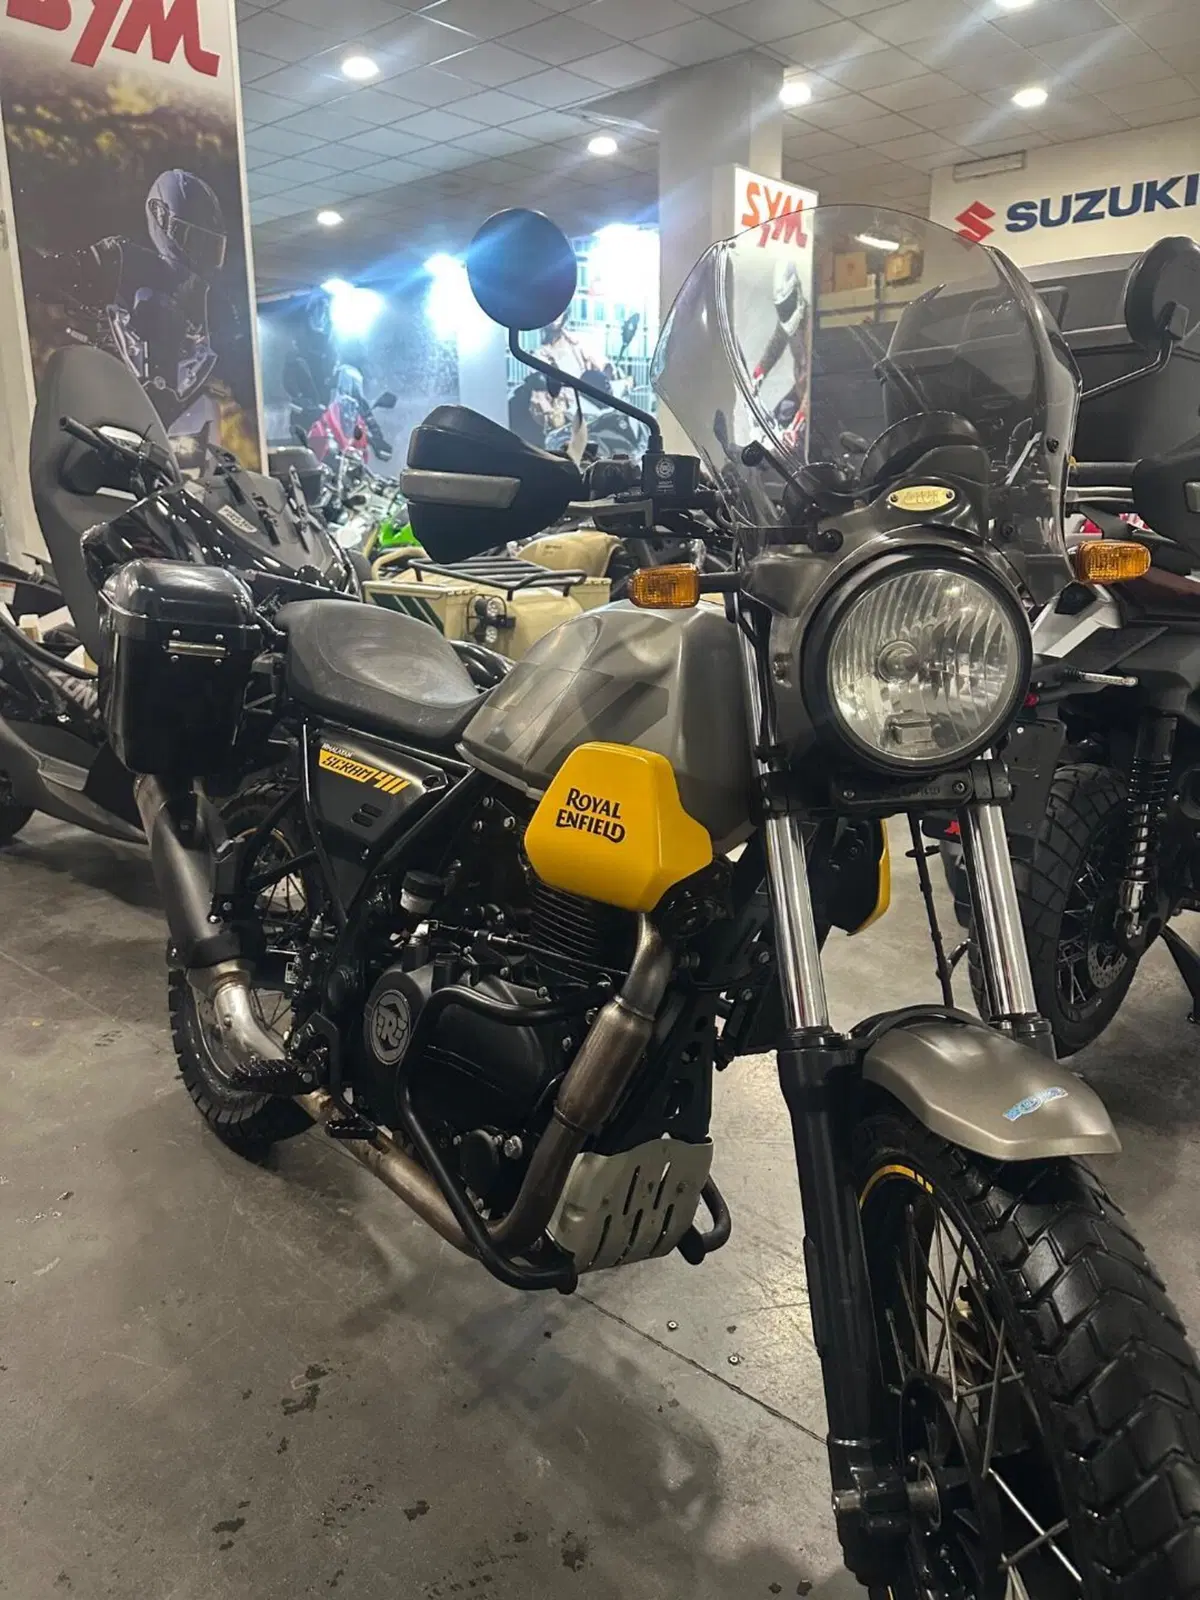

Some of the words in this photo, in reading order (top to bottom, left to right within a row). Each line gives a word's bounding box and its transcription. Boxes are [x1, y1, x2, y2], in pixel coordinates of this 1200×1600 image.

[741, 181, 808, 248] SYM
[1005, 173, 1200, 233] SUZUKI
[322, 756, 374, 780] SCRAM
[566, 788, 622, 820] ROYAL
[556, 808, 626, 844] ENFIELD
